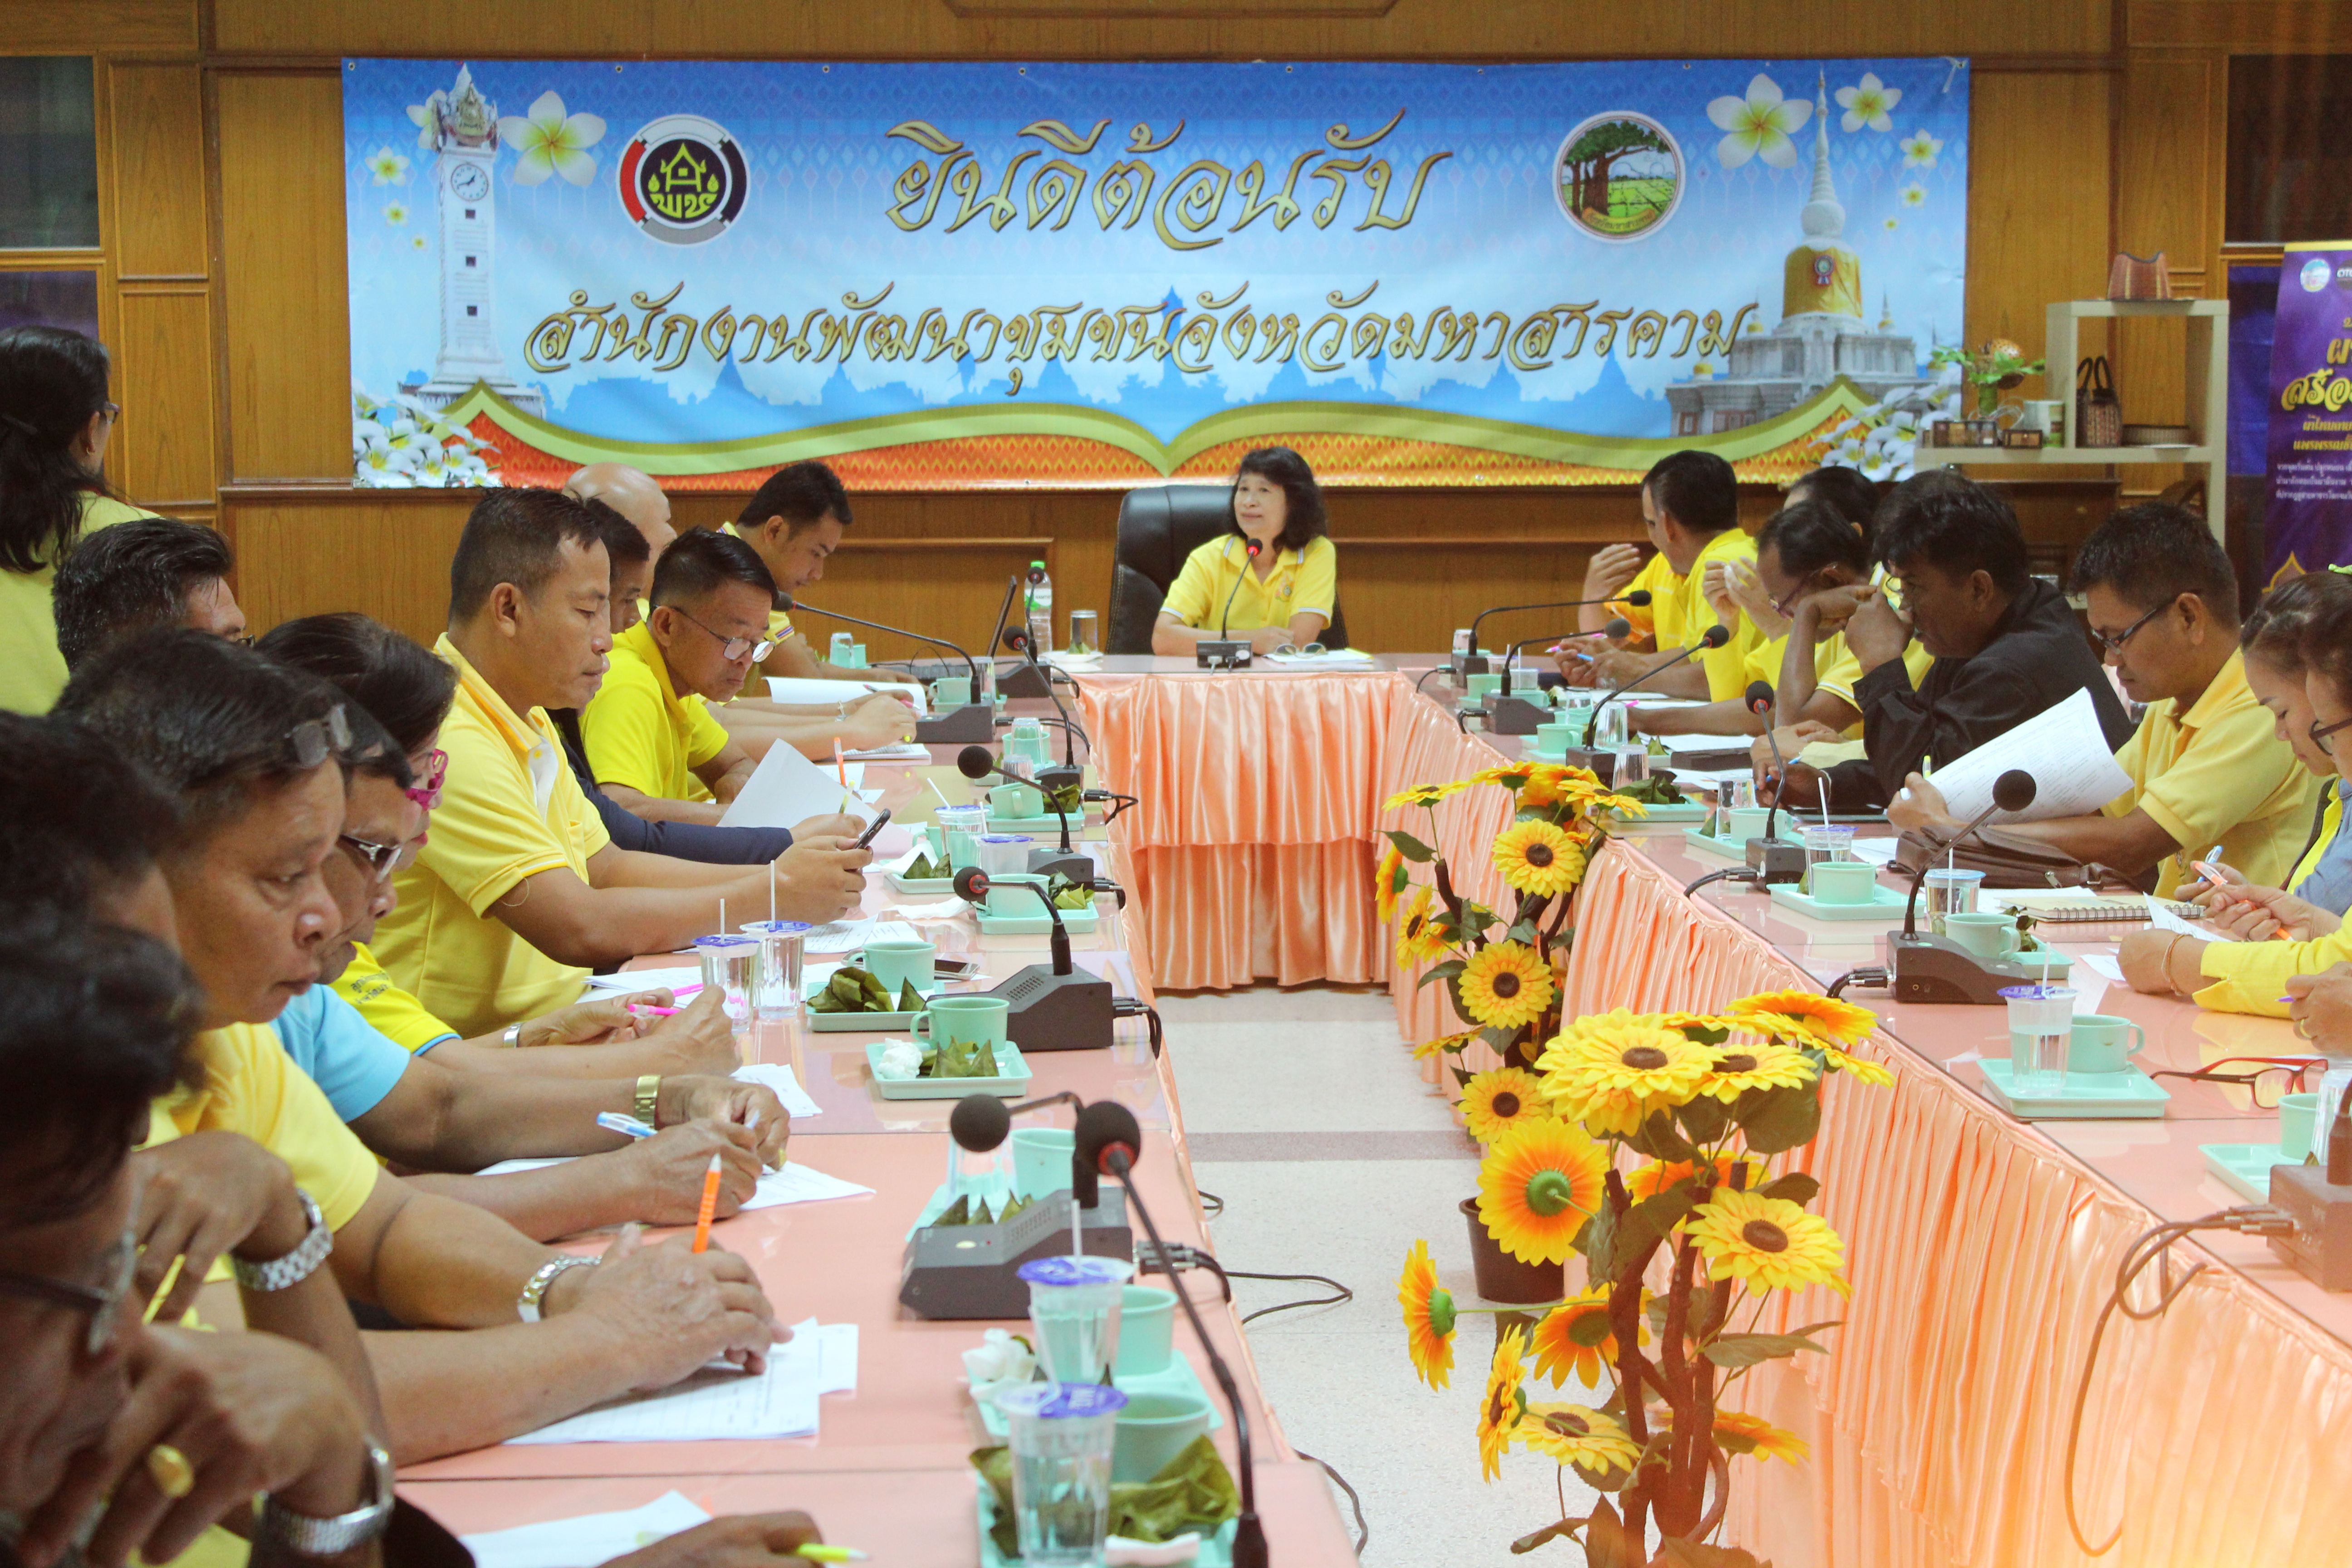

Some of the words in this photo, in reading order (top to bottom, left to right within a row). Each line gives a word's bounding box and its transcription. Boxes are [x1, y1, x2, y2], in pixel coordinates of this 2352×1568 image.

[886, 107, 1453, 250] ยินดีต้อนรับ
[2281, 368, 2352, 412] สร้อ
